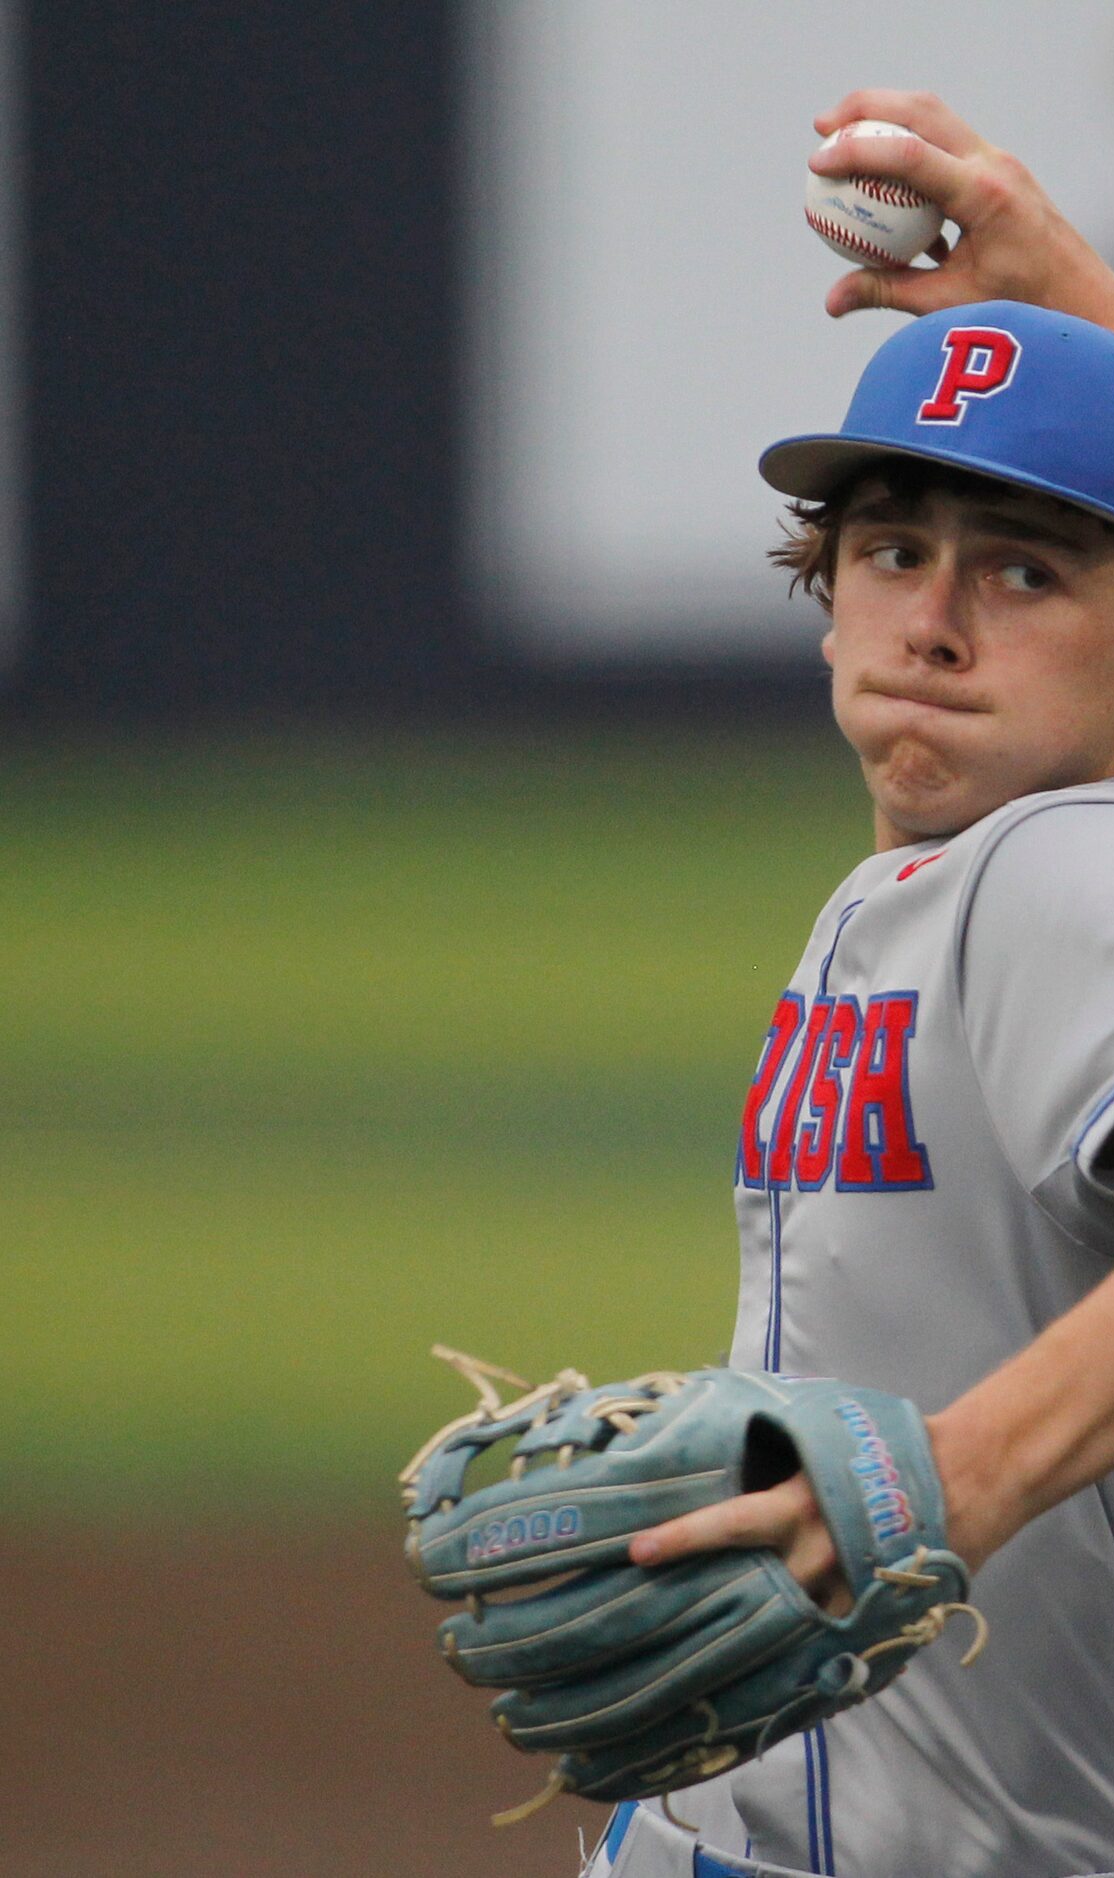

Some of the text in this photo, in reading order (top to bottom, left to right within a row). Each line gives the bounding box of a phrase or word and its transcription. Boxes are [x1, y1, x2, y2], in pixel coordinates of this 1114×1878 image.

[916, 326, 1023, 426] P
[835, 1398, 913, 1544] Wilson
[467, 1505, 582, 1564] A2000
